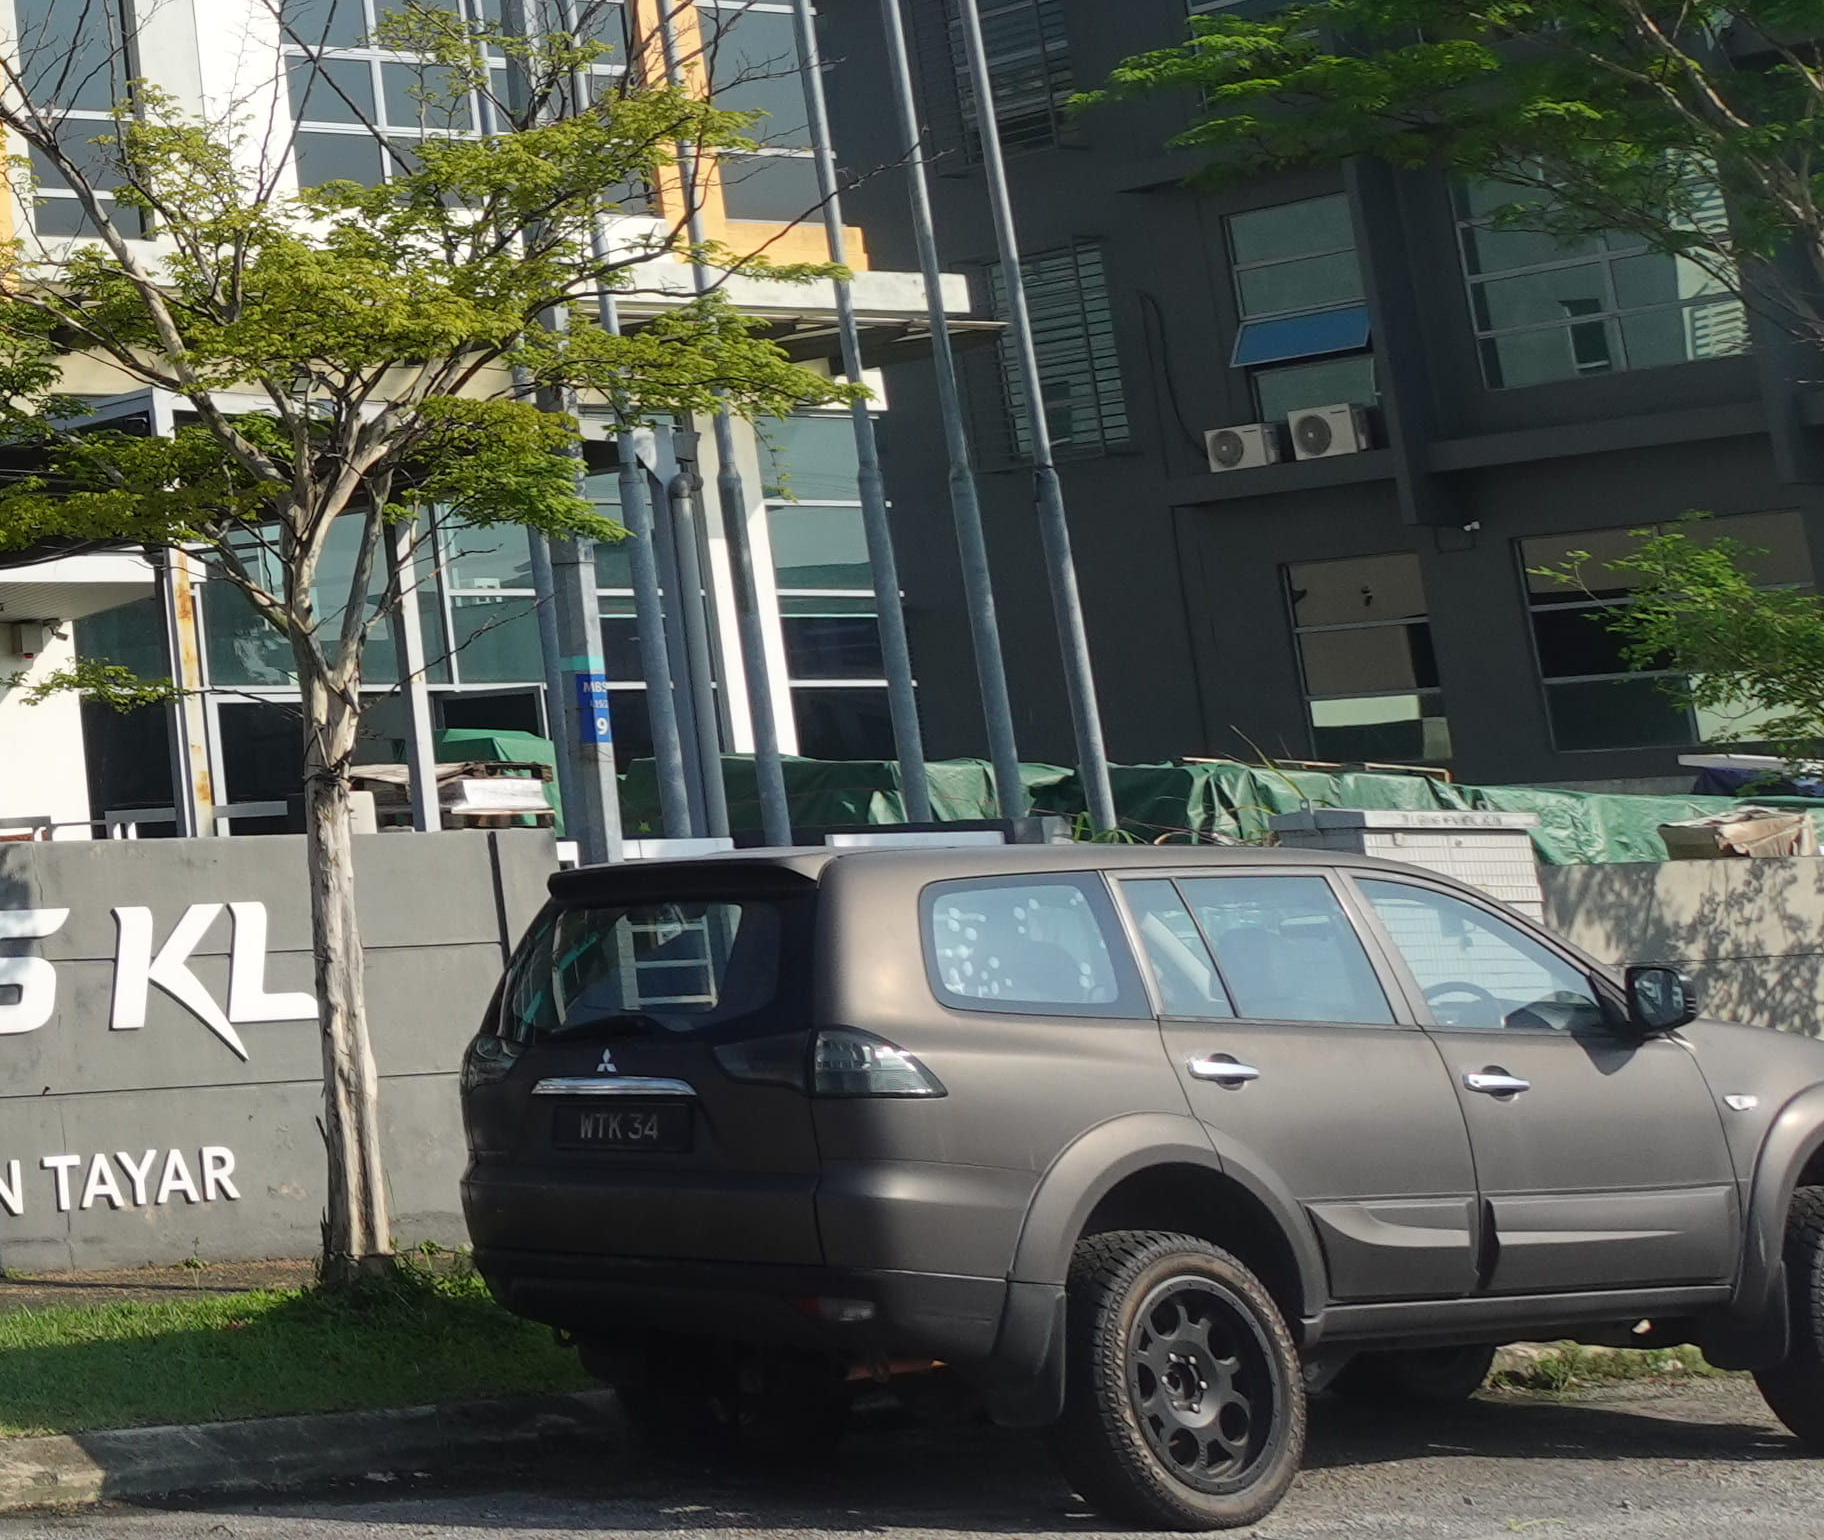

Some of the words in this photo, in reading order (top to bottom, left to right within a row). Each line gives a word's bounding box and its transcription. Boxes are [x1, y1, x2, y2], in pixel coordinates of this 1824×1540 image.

[596, 717, 608, 735] 9
[110, 901, 320, 1062] KL
[580, 1112, 623, 1139] WTK
[627, 1112, 659, 1139] 34
[40, 1145, 241, 1212] TAYAR
